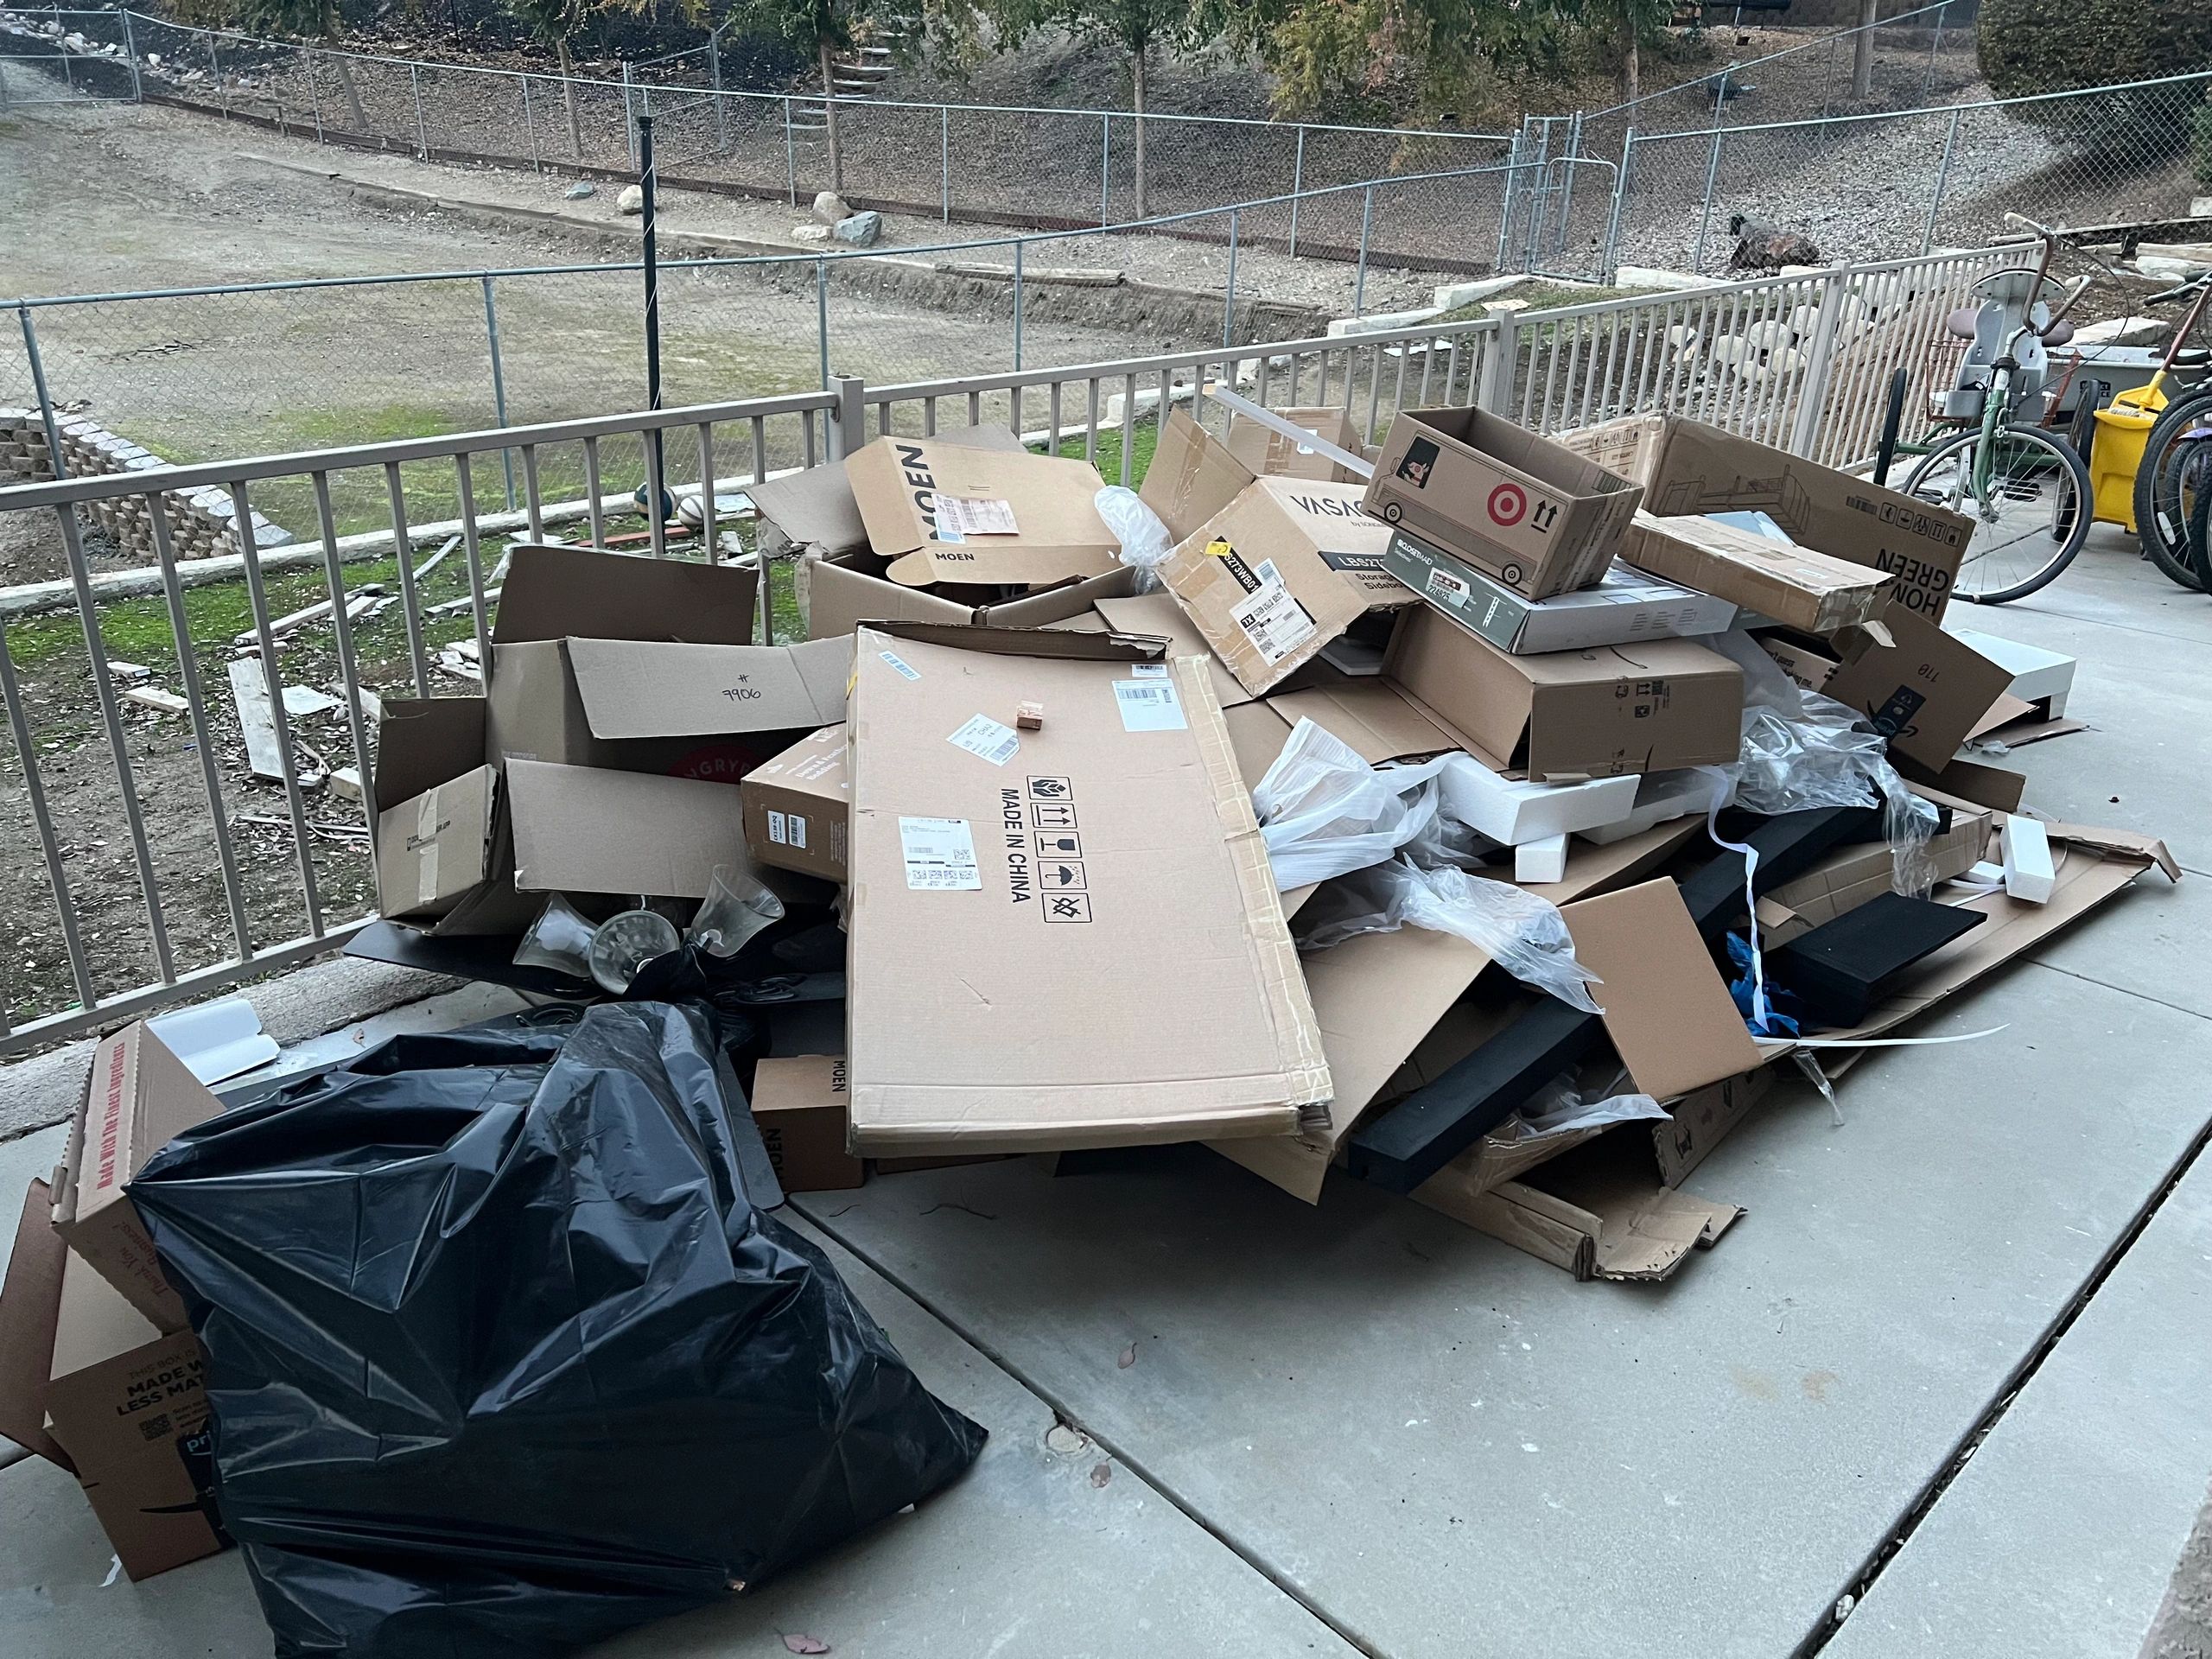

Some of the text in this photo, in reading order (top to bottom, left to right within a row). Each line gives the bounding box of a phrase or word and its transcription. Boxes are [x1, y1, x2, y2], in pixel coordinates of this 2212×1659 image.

[1224, 552, 1259, 592] S273WB01
[1338, 556, 1383, 568] LBS27
[1356, 573, 1394, 582] Storag
[1875, 549, 1949, 592] GREEN
[737, 674, 750, 683] #
[1001, 788, 1032, 904] MADE IN CHINA
[831, 1060, 846, 1092] MOEN
[97, 1041, 125, 1190] Made With The Finest Ingredients
[126, 1365, 184, 1397] MADE
[129, 1363, 155, 1380] THIS
[157, 1354, 181, 1370] BOX
[116, 1390, 163, 1417] LESS
[167, 1372, 204, 1398] MAT
